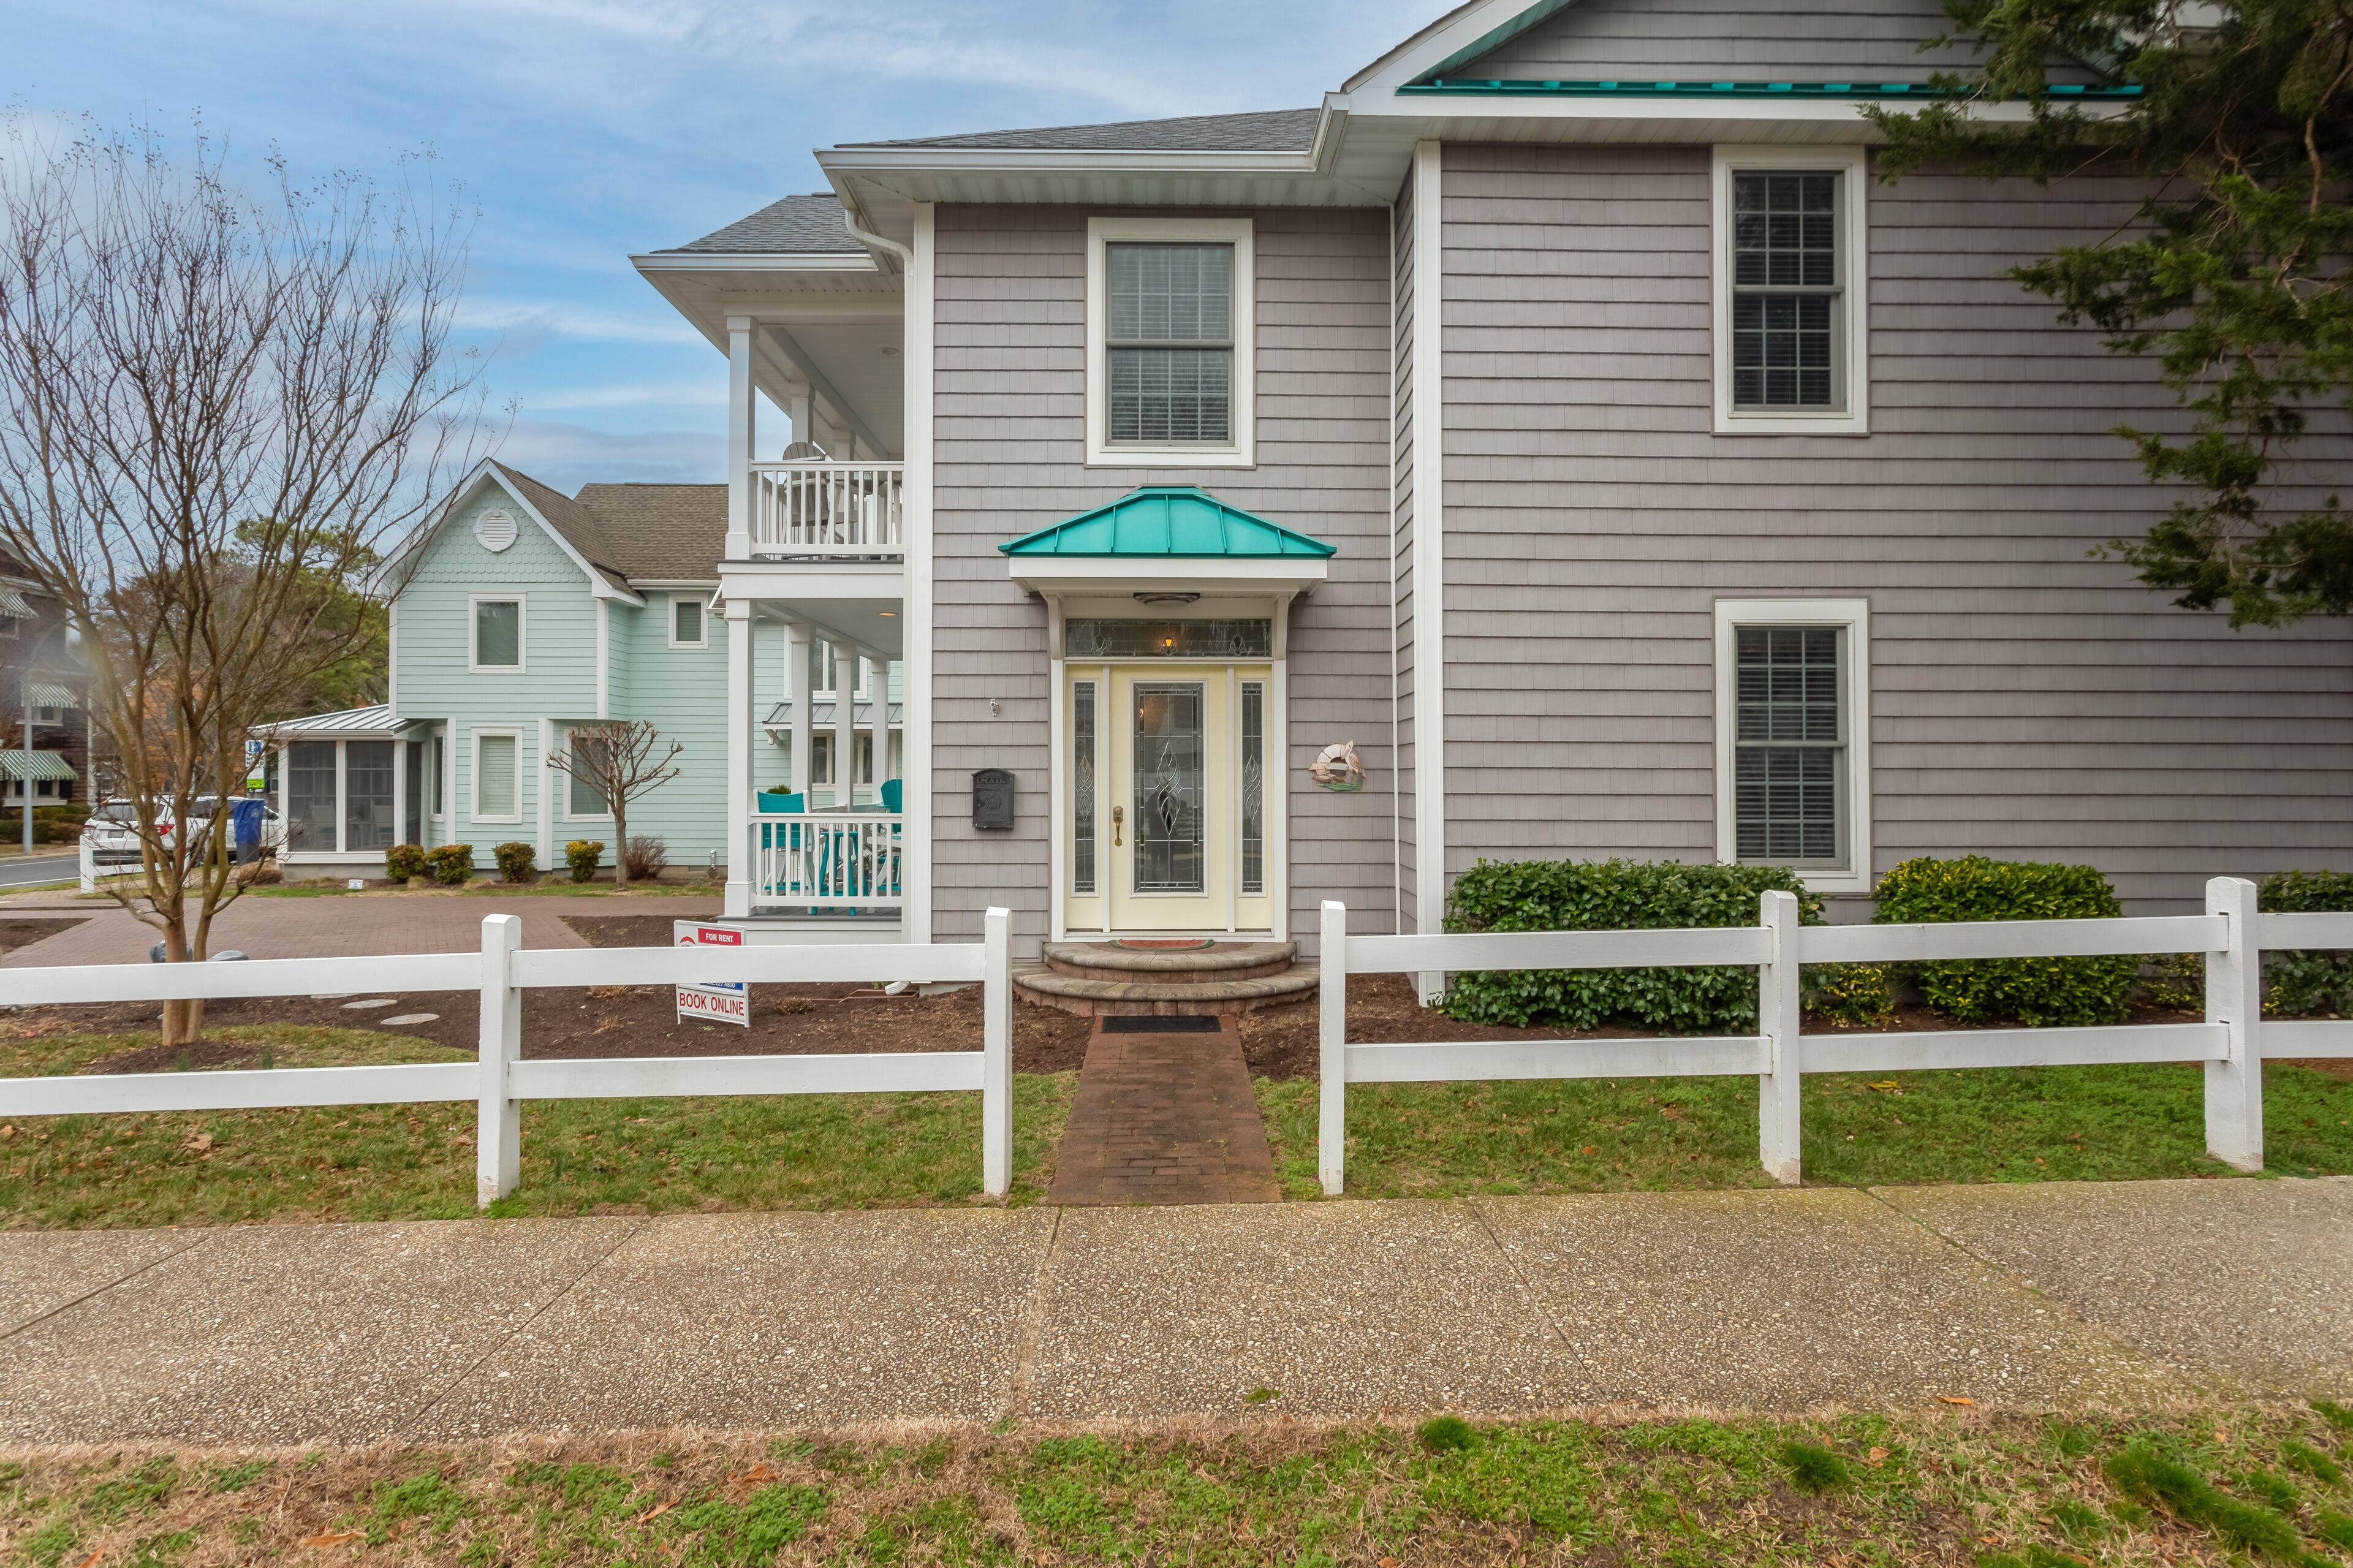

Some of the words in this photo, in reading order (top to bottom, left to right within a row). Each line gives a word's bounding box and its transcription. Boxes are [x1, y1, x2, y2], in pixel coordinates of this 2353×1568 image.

[705, 933, 717, 941] FOR
[718, 934, 733, 943] RENT
[679, 993, 707, 1010] BOOK
[711, 996, 744, 1016] ONLINE
